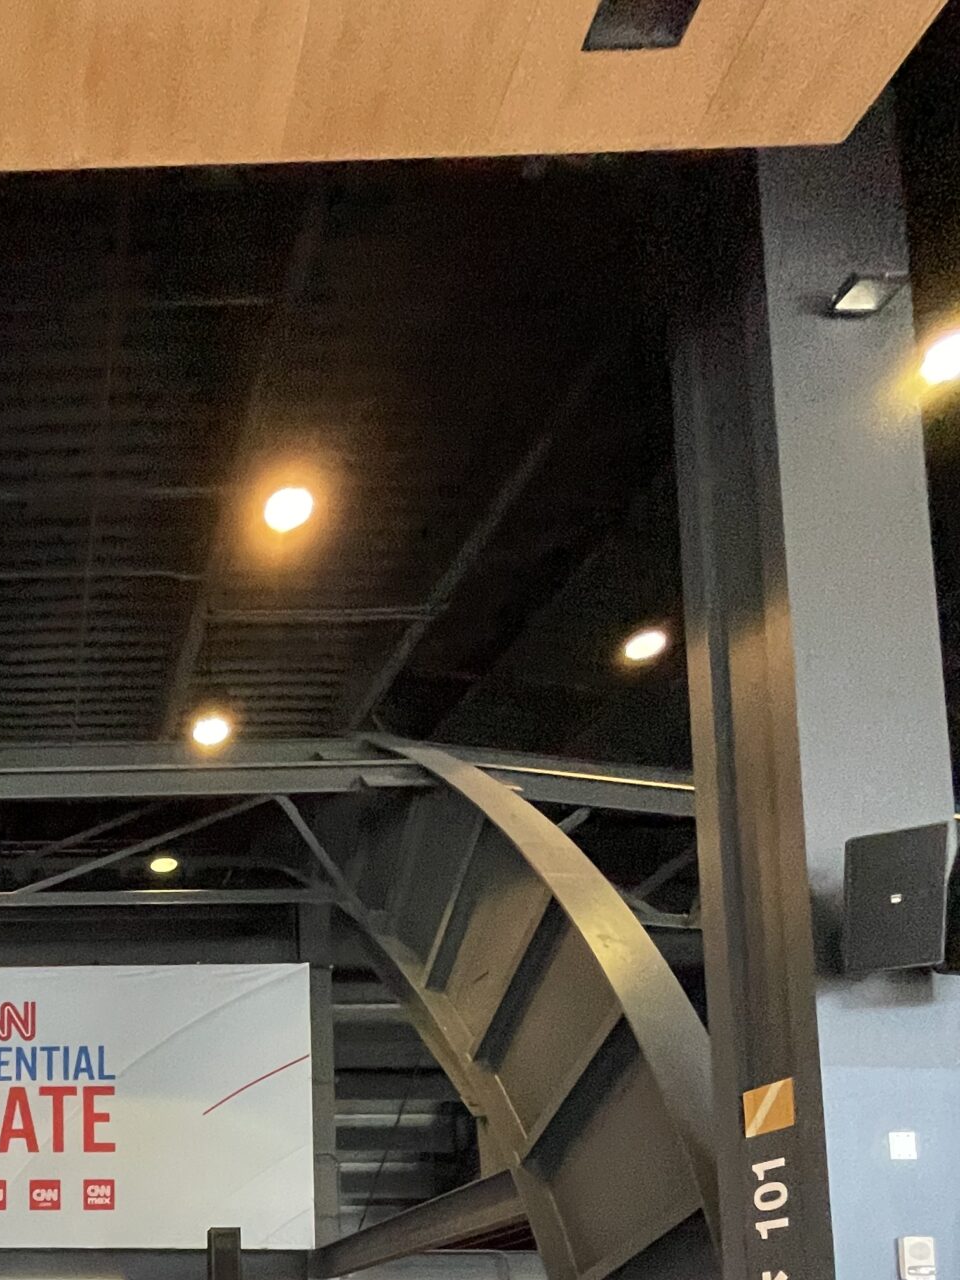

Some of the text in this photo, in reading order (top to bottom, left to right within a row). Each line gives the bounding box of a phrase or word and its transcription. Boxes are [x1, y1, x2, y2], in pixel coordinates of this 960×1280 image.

[32, 1188, 58, 1201] CNN
[86, 1185, 111, 1197] CNN
[87, 1197, 111, 1205] max
[751, 1157, 789, 1239] 101
